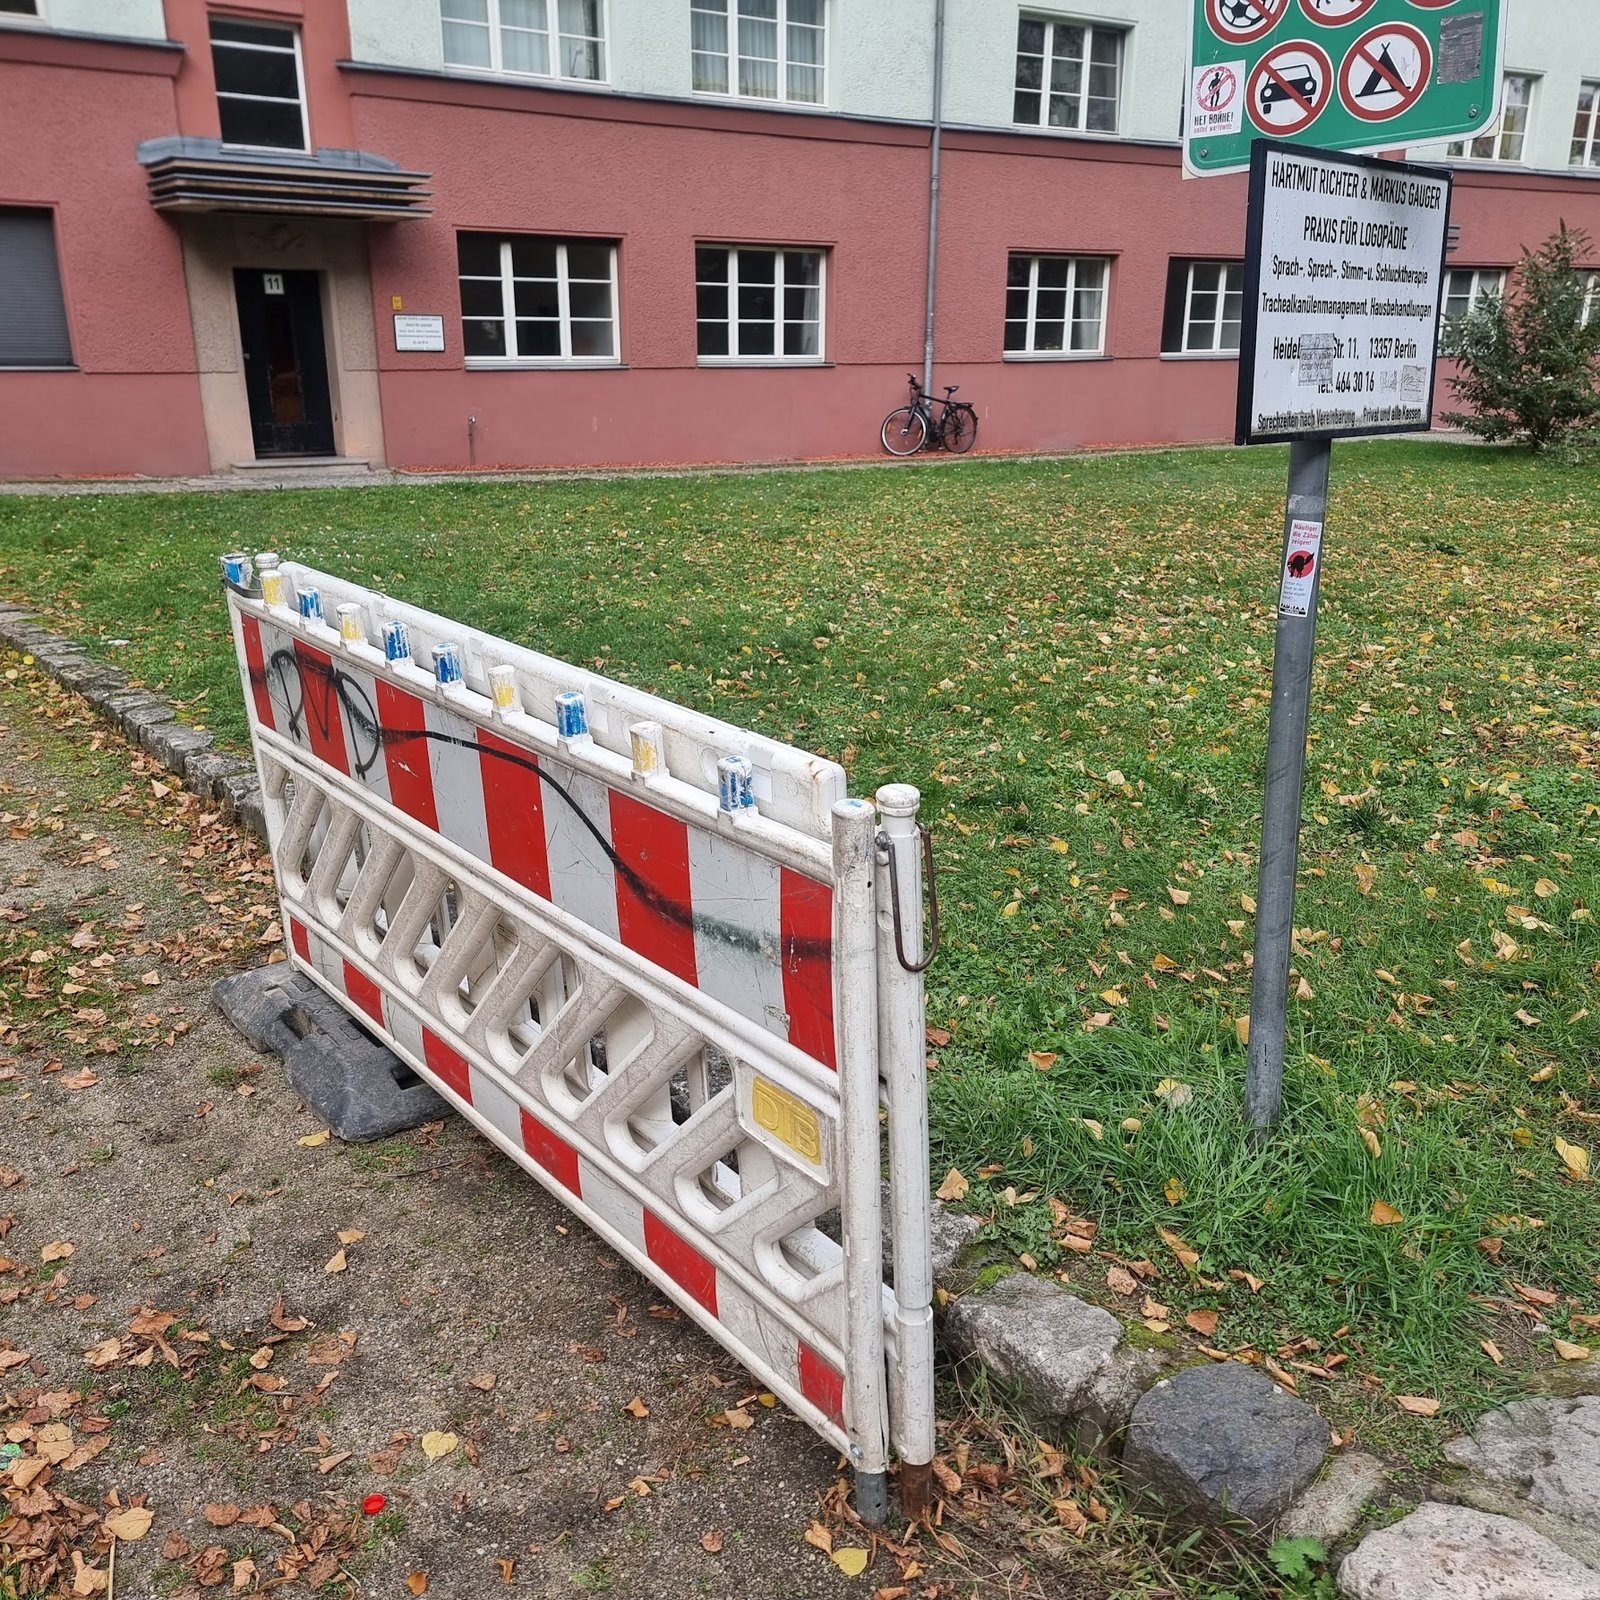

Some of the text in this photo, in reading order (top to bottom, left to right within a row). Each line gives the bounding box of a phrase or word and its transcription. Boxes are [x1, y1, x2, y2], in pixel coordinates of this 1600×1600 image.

[1194, 111, 1234, 126] НЕТ ВОЙНЕ!
[1272, 160, 1441, 210] HARTMUT RICHTER & MARKUS GAUGER
[1304, 215, 1408, 250] PRAXIS FÜR LOGOPÄDIE
[266, 277, 280, 290] 11
[1375, 262, 1428, 288] Schlucktherapie
[1262, 292, 1432, 321] Trachealkanülenmanagement, Hausbehandlungen
[1348, 337, 1359, 360] 11,
[1370, 337, 1393, 359] 13357
[1394, 337, 1417, 359] Berlin
[1335, 371, 1351, 393] 464
[1353, 371, 1363, 392] 30
[1365, 371, 1375, 392] 16
[1258, 404, 1421, 431] Sprechzeiten nach Vereinbarung Privat und alle Kassen
